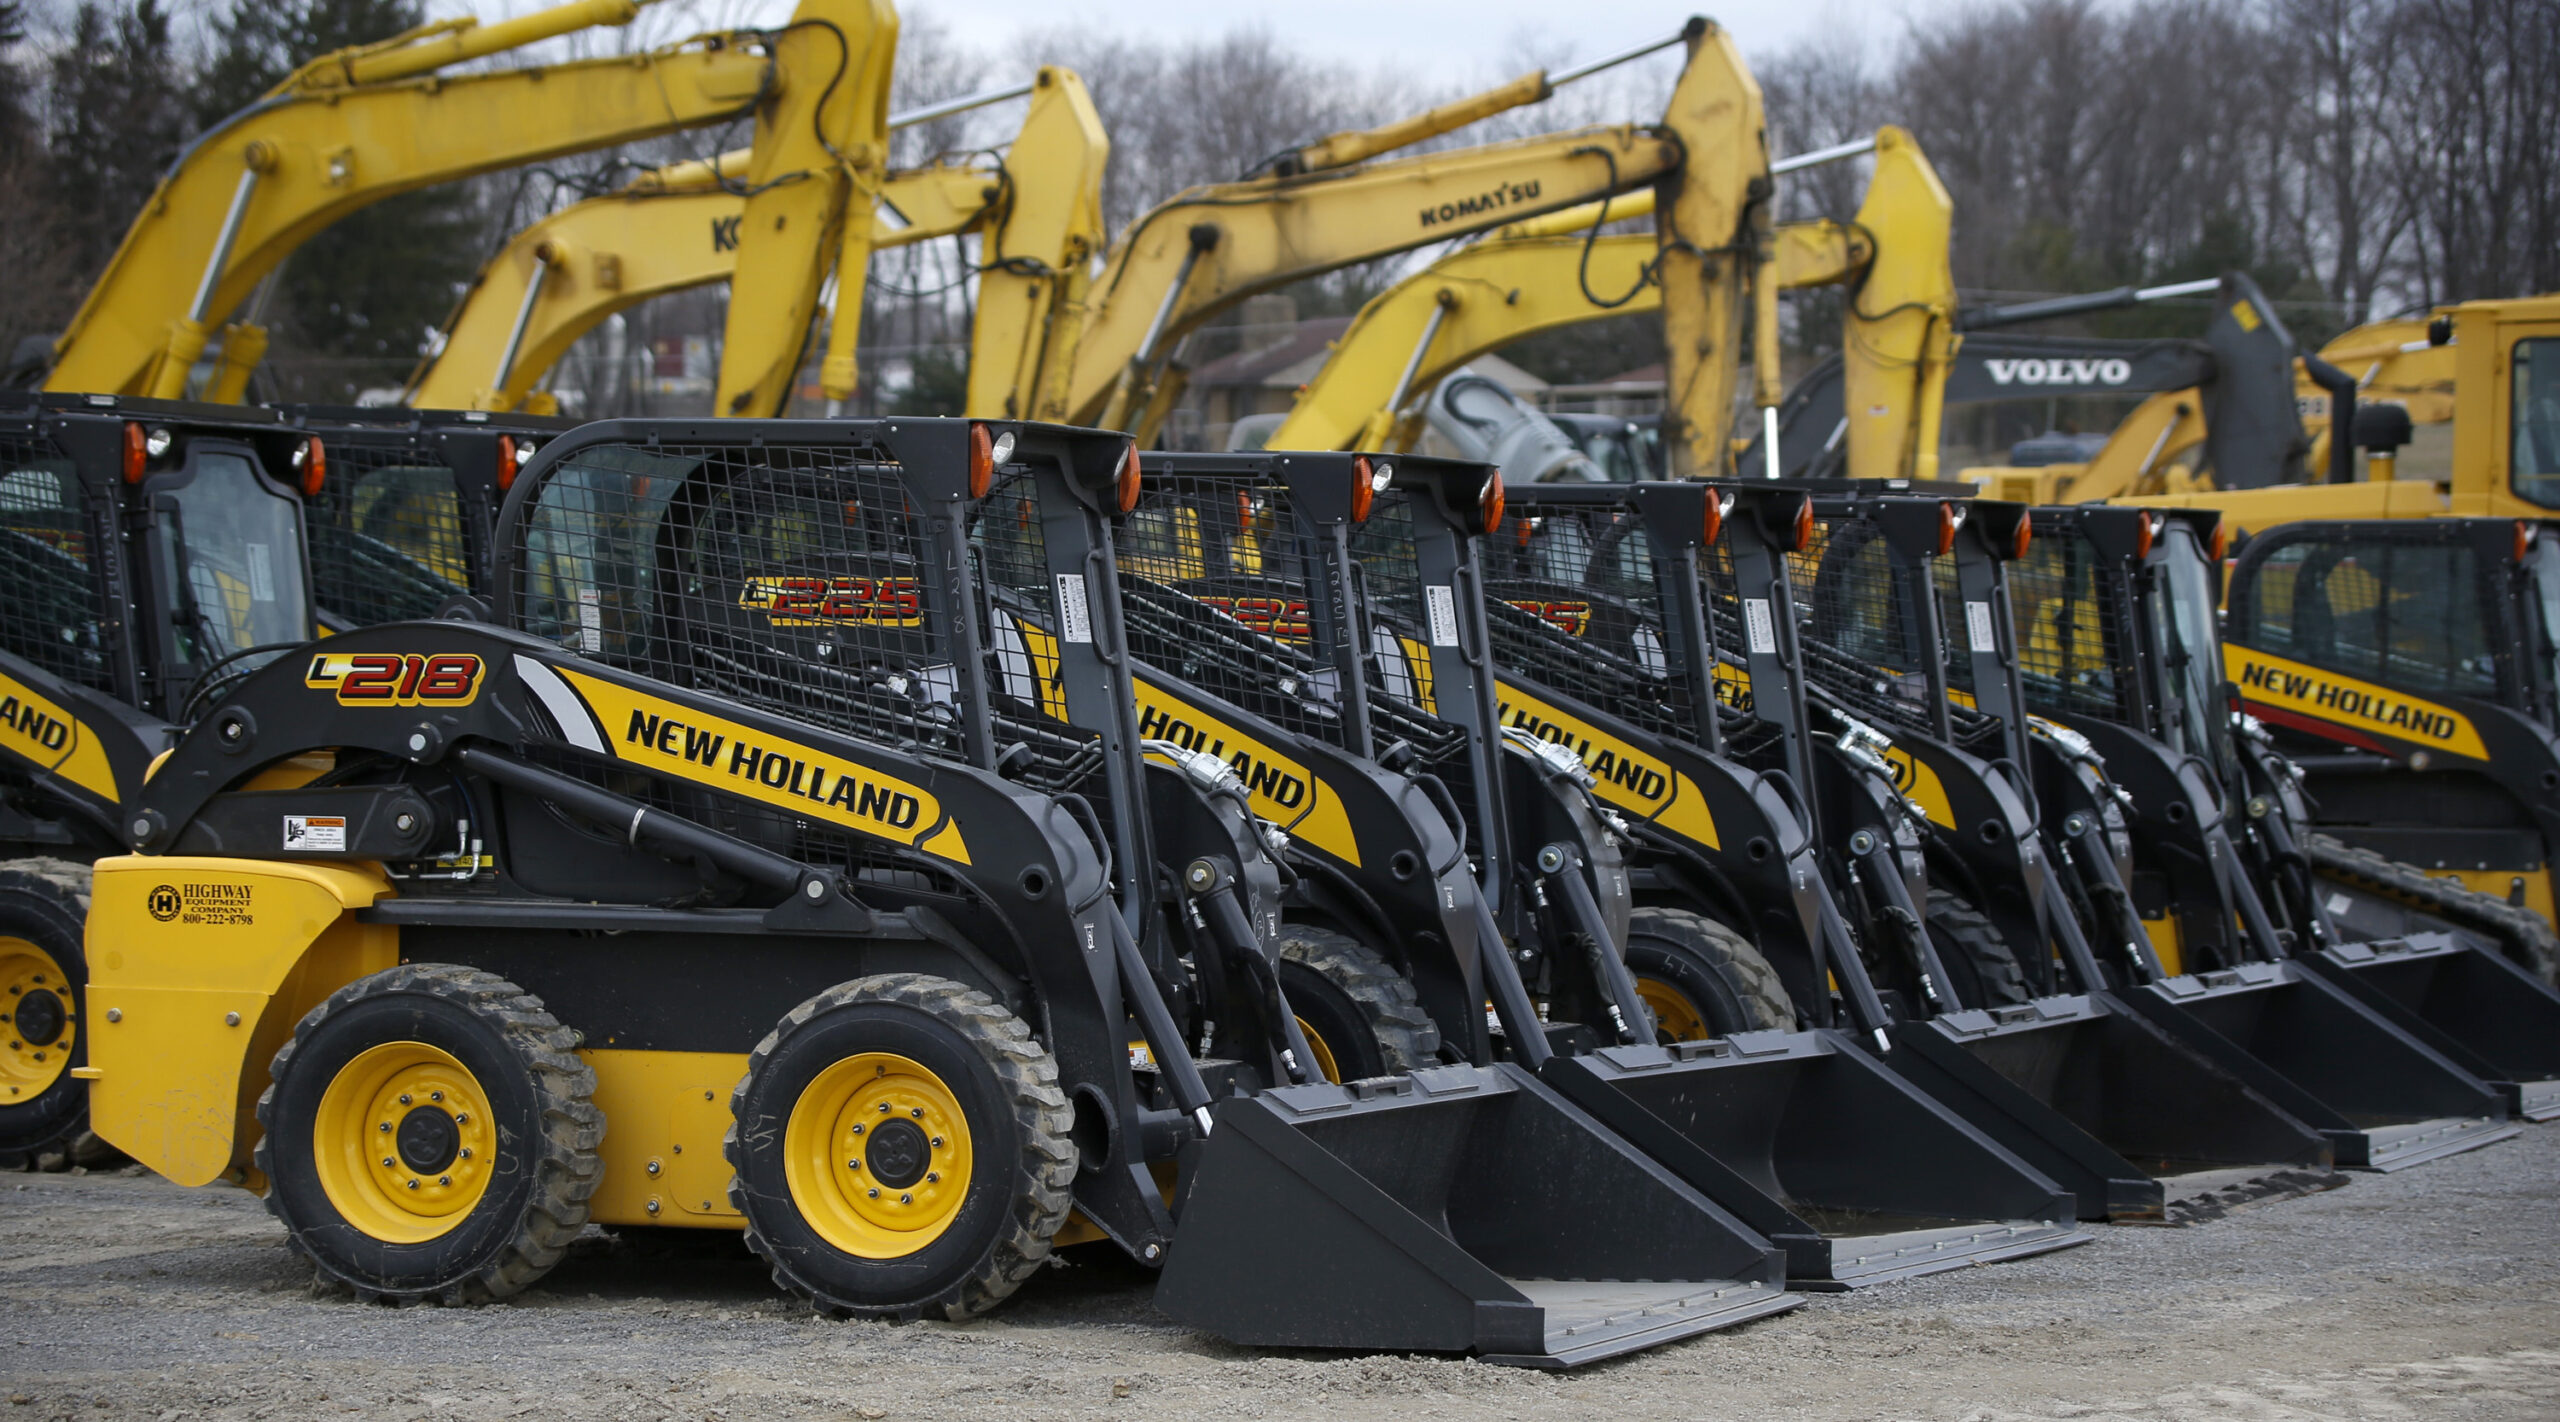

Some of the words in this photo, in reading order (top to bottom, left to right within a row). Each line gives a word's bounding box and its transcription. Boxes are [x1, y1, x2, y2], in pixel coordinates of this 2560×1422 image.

[1420, 180, 1540, 226] KOMATSU
[1984, 358, 2132, 385] VOLVO
[741, 579, 921, 620] L225
[307, 656, 482, 699] L218
[2242, 661, 2312, 699] NEW
[2316, 682, 2456, 740] HOLLAND
[0, 694, 68, 751] AND
[626, 708, 725, 767] NEW
[728, 741, 920, 830] HOLLAND
[183, 884, 253, 898] HIGHWAY
[185, 898, 251, 906] EQUIPMENT
[183, 914, 254, 925] 800-222-8798
